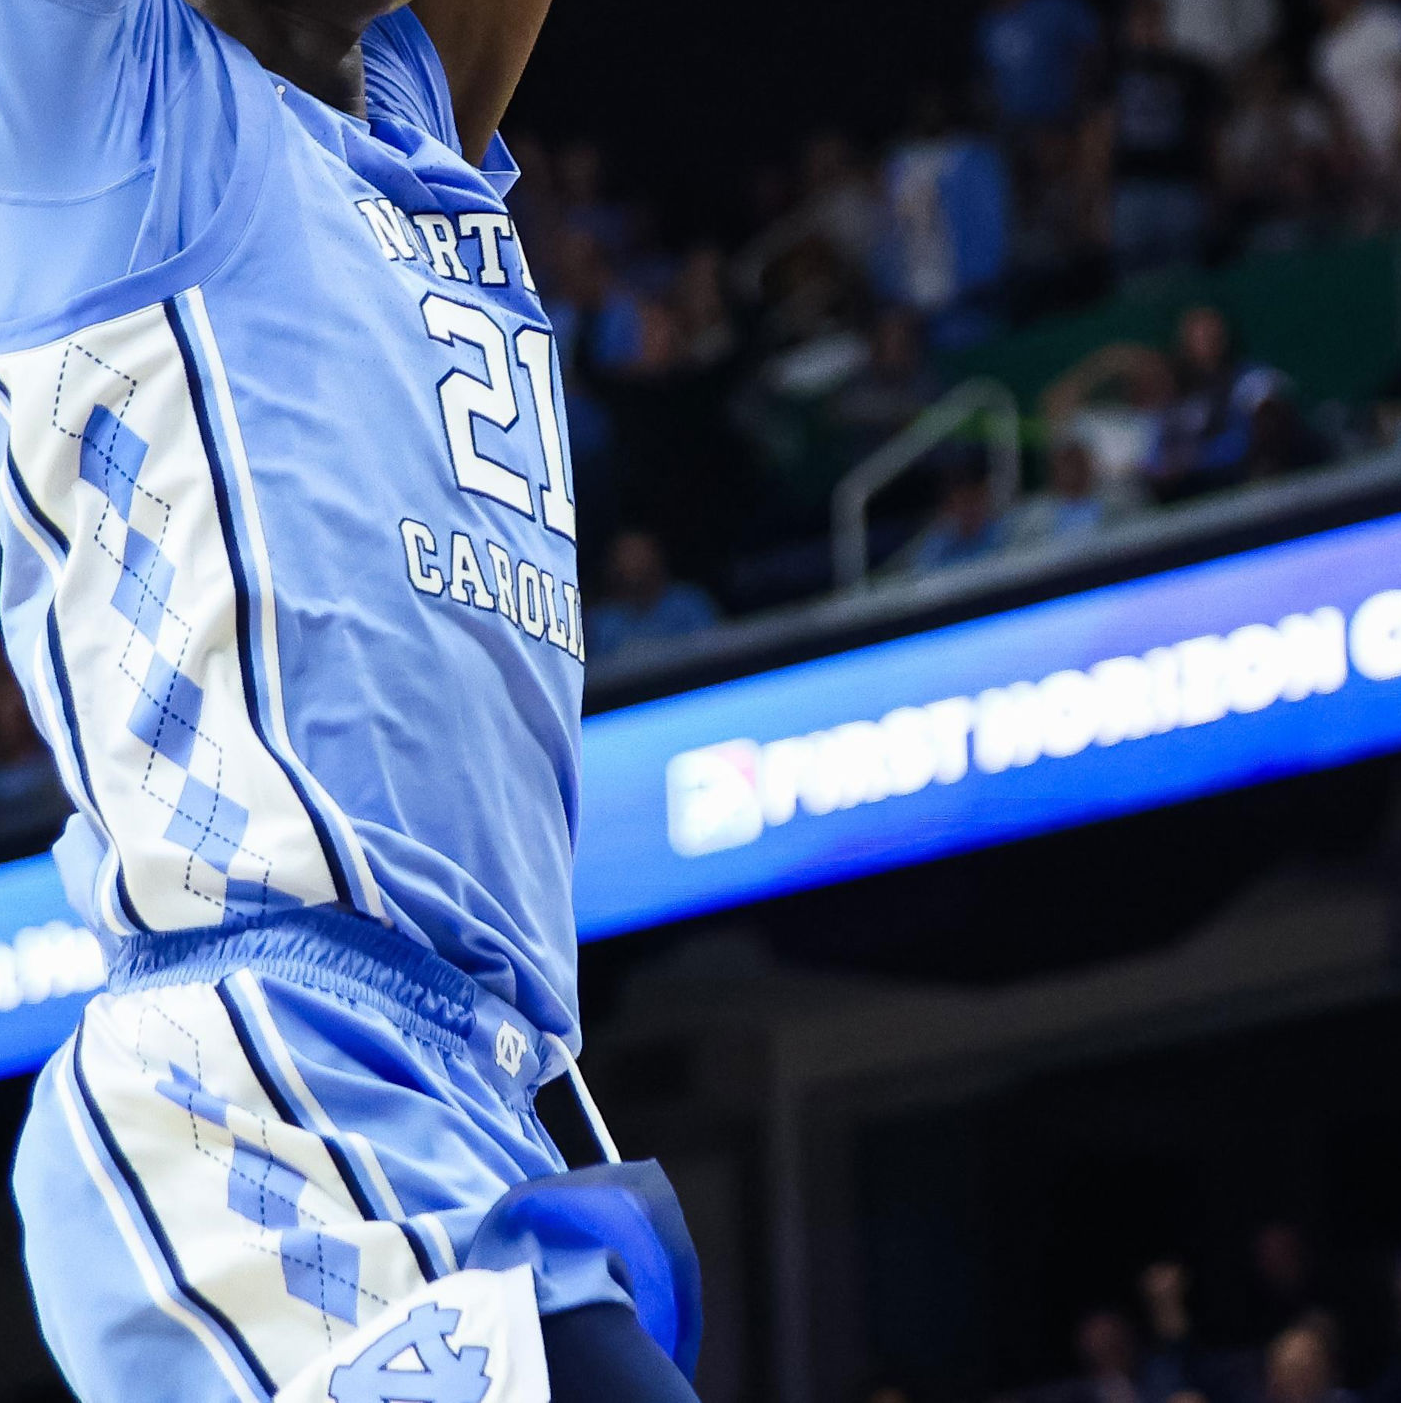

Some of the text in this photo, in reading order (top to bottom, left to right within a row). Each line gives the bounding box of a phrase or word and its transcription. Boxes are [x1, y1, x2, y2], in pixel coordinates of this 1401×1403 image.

[355, 197, 540, 292] NRT
[420, 291, 578, 543] 21
[399, 517, 586, 666] CAROLI
[761, 694, 976, 827] FIRST
[972, 605, 1348, 774] HORIZON
